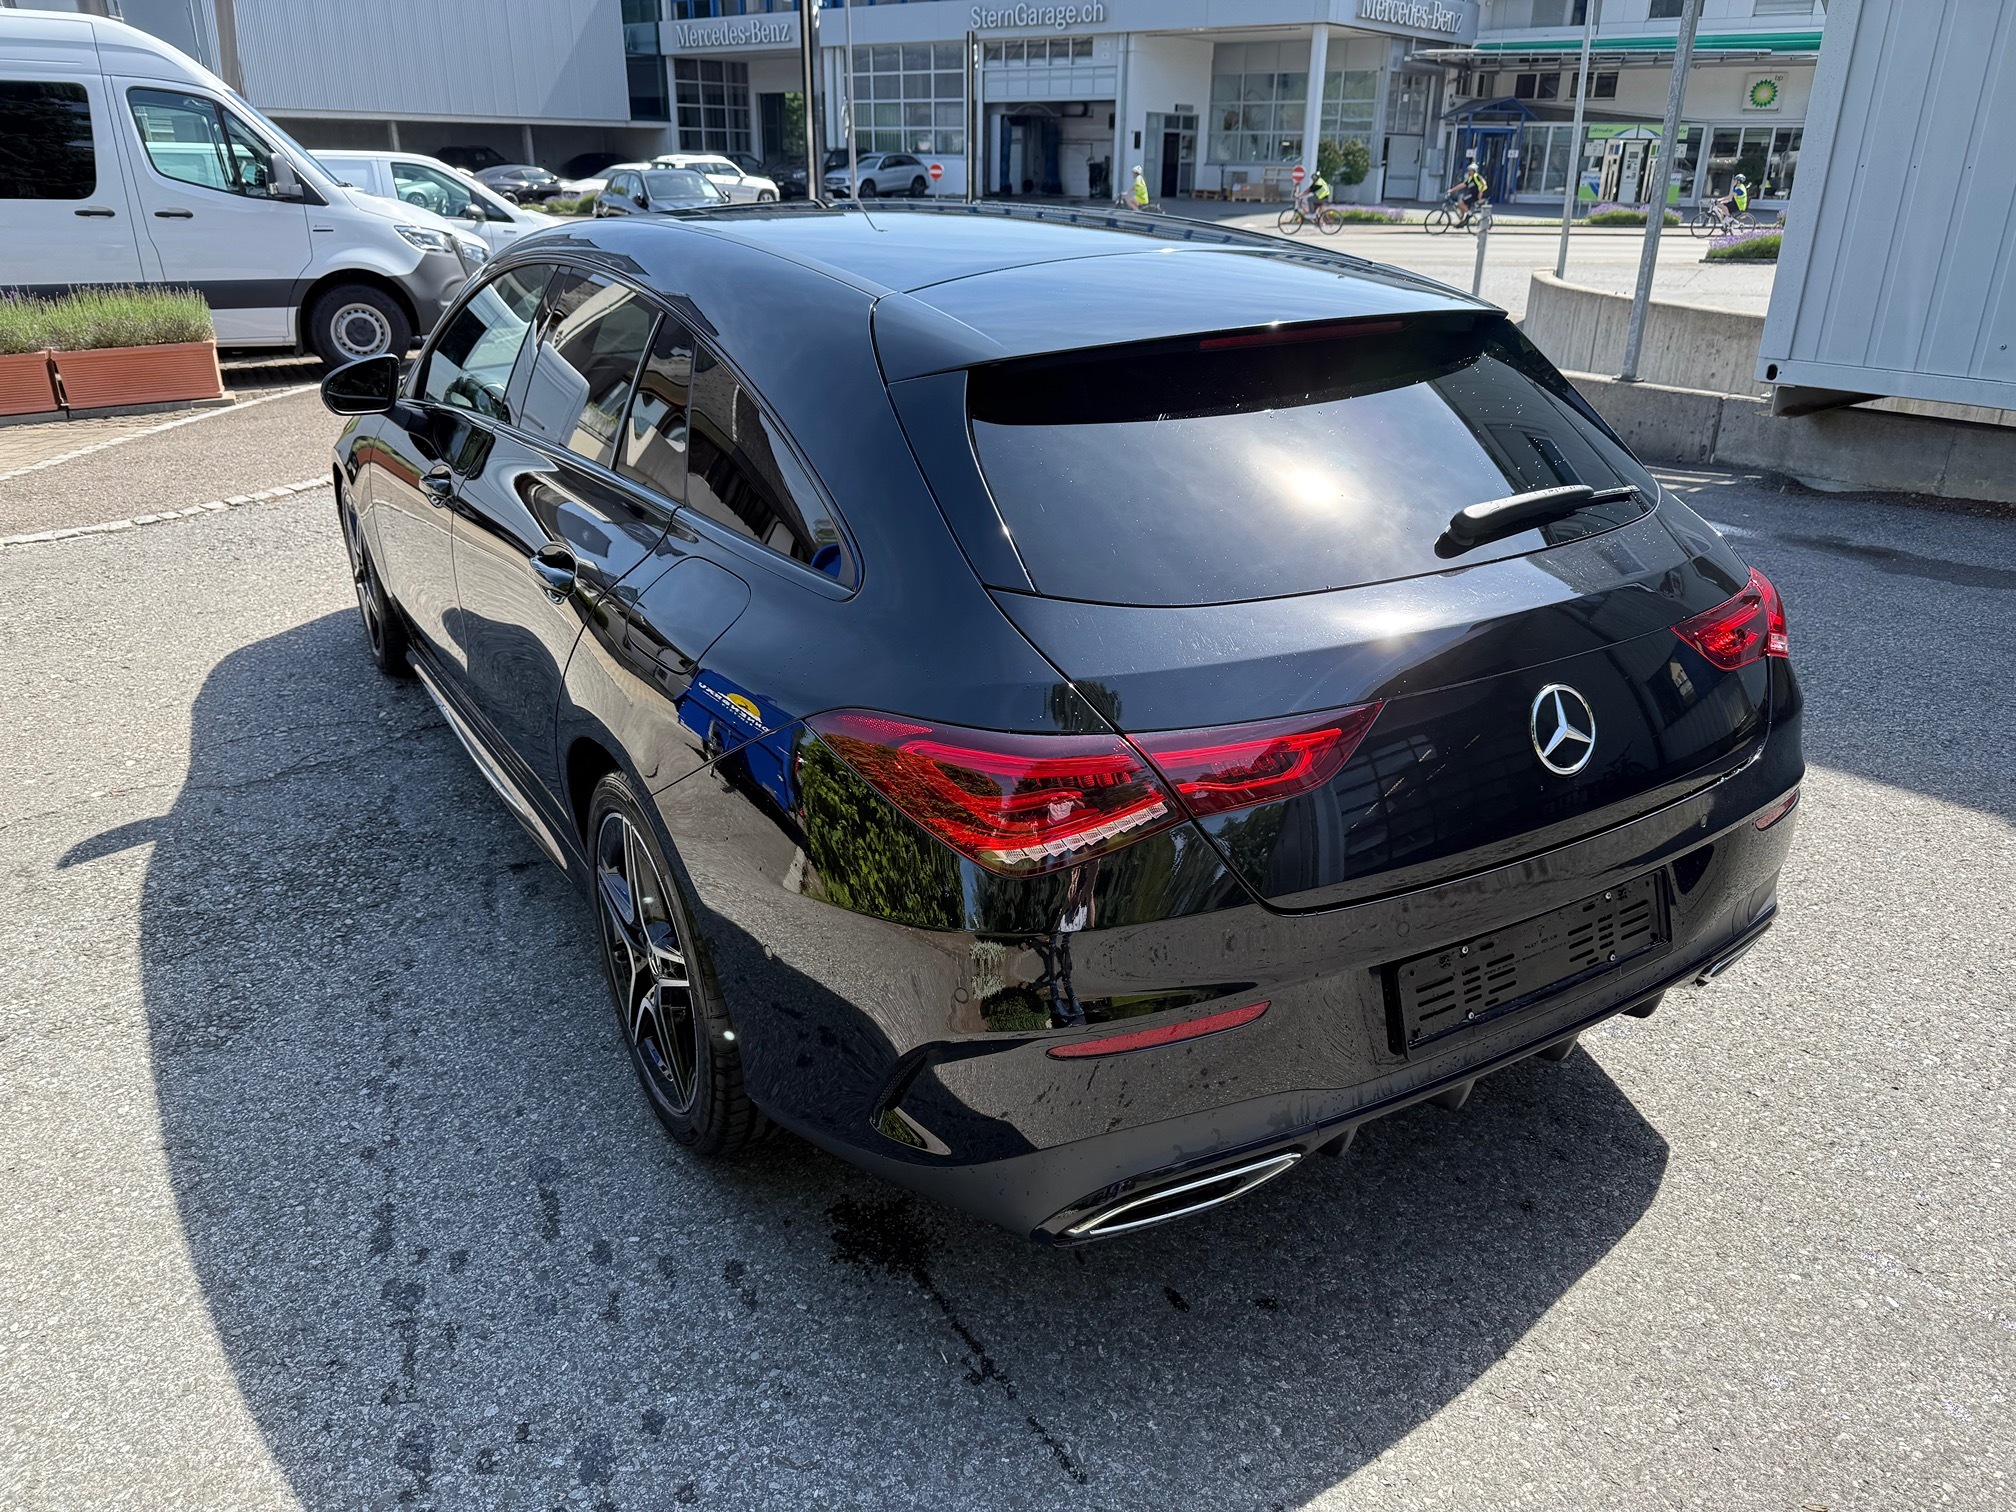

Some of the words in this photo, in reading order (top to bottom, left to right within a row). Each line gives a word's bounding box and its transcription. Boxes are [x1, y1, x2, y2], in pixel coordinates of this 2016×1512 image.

[970, 0, 1104, 30] SternGarage.ch
[1360, 0, 1463, 33] Mercedes-Benz
[675, 19, 790, 48] Mercedes-Benz
[1774, 74, 1784, 82] bp
